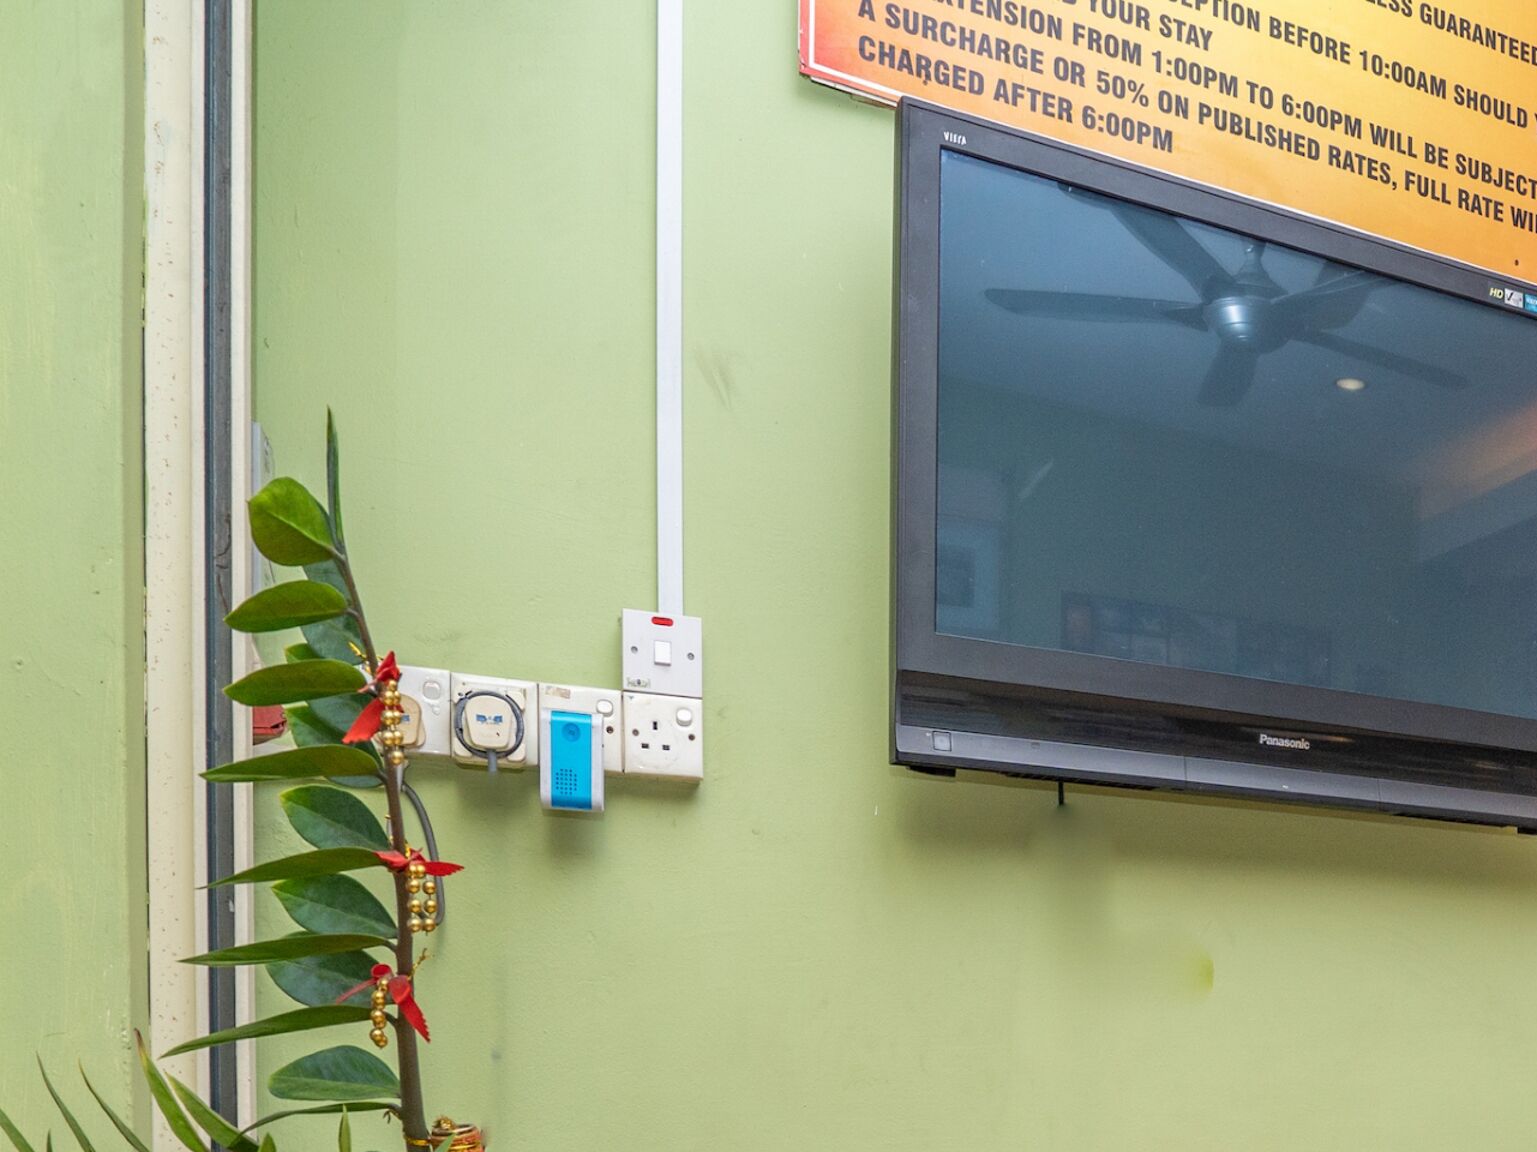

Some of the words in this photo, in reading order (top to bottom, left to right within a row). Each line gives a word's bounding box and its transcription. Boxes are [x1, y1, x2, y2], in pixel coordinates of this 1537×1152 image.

[1159, 14, 1213, 51] STAY
[1268, 15, 1351, 65] BEFORE
[1359, 50, 1446, 100] 10:00AM
[1454, 84, 1528, 130] SHOULD
[858, 35, 985, 96] CHARGED
[993, 80, 1073, 124] AFTER
[1082, 105, 1174, 154] 6:00PM
[858, 0, 876, 23] A
[885, 4, 1044, 74] SURCHARGE
[1053, 56, 1086, 88] OR
[1097, 71, 1149, 108] 50%
[1158, 89, 1190, 120] ON
[1199, 102, 1320, 162] PUBLISHED
[1328, 145, 1398, 191] RATES,
[1404, 170, 1452, 206] FULL
[1457, 188, 1504, 222] RATE
[1073, 22, 1142, 66] FROM
[1152, 50, 1238, 99] 1:00PM
[1246, 80, 1273, 110] TO
[1281, 93, 1363, 140] 6:00PM
[1369, 122, 1417, 159] WILL
[1425, 141, 1449, 170] BE
[1259, 733, 1310, 750] Panasonic
